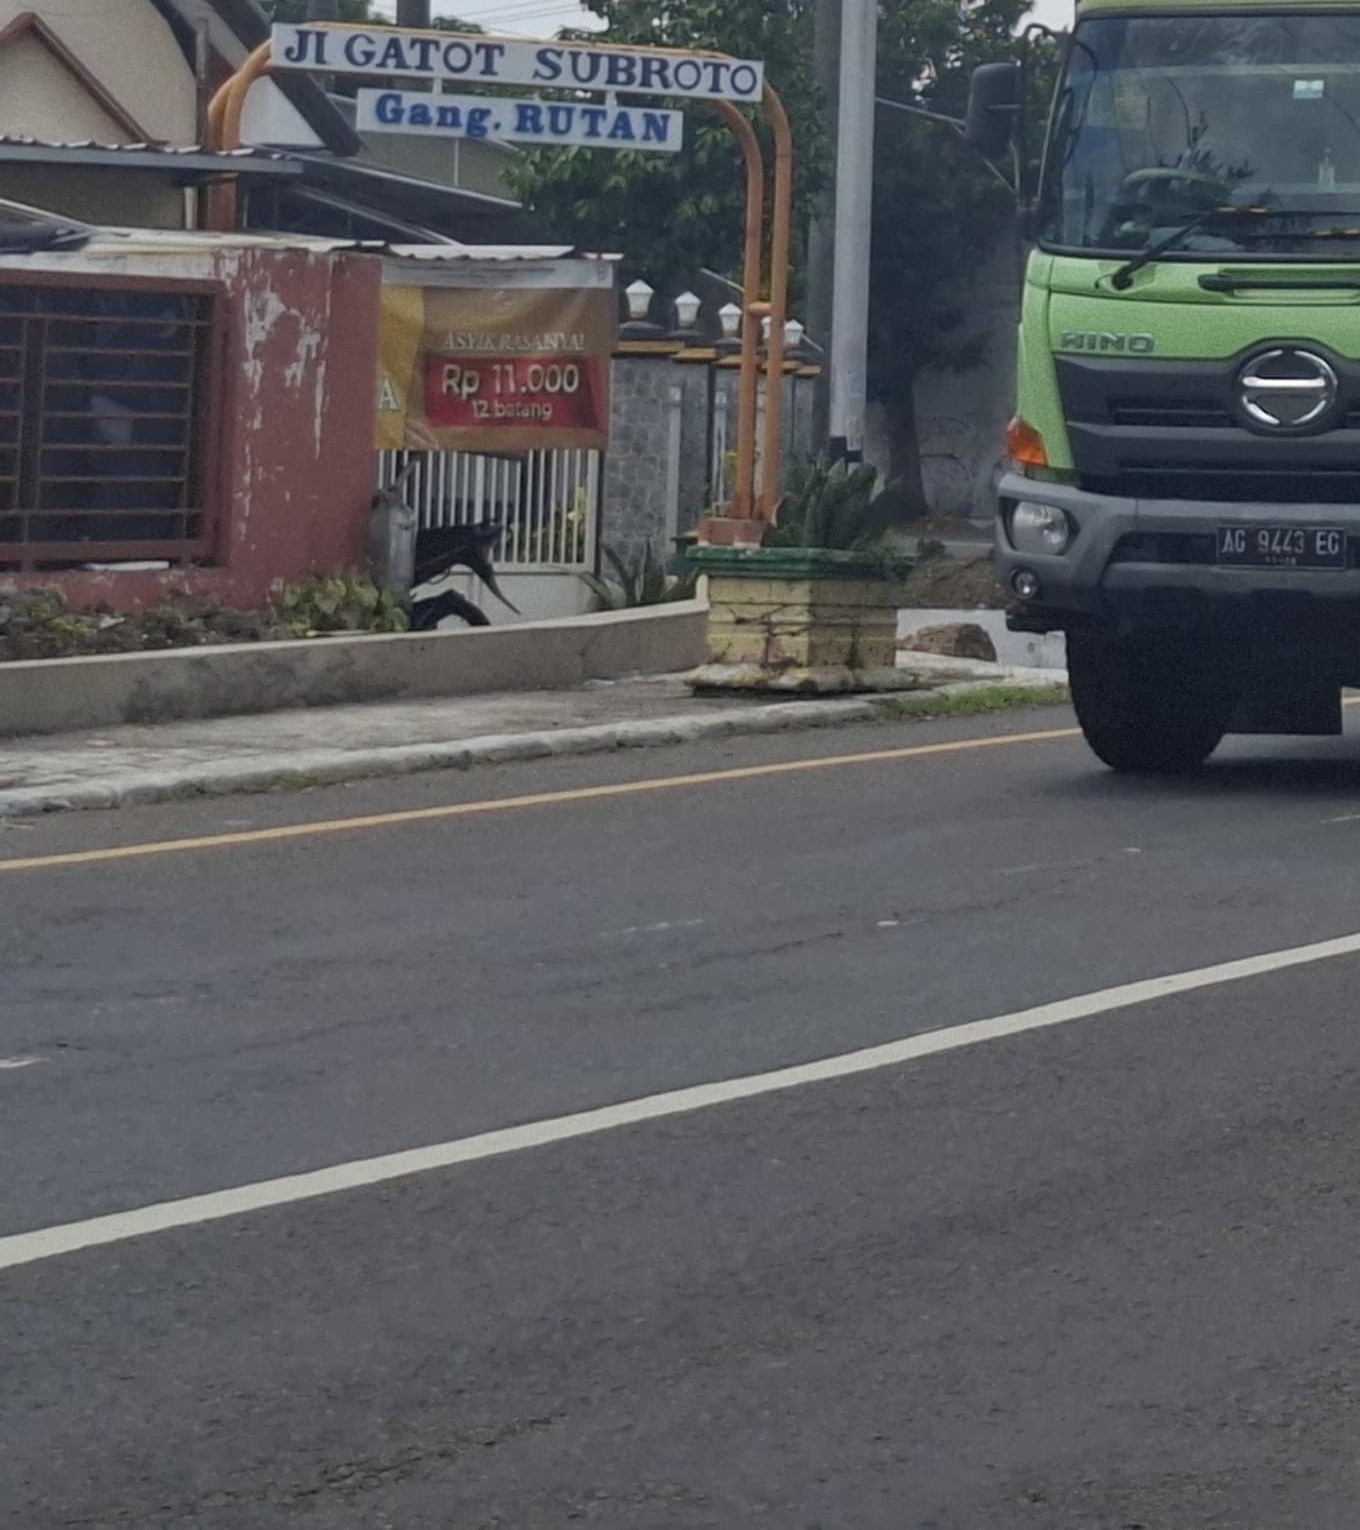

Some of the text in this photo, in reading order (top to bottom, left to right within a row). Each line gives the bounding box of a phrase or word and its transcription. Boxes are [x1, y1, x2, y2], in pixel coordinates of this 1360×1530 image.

[344, 33, 504, 76] GATOT
[532, 47, 757, 95] SUBROTO
[375, 94, 671, 142] Gang. RUTAN
[1061, 330, 1154, 353] HINO
[442, 364, 580, 399] Rp 11.000
[472, 400, 552, 421] 12 batang
